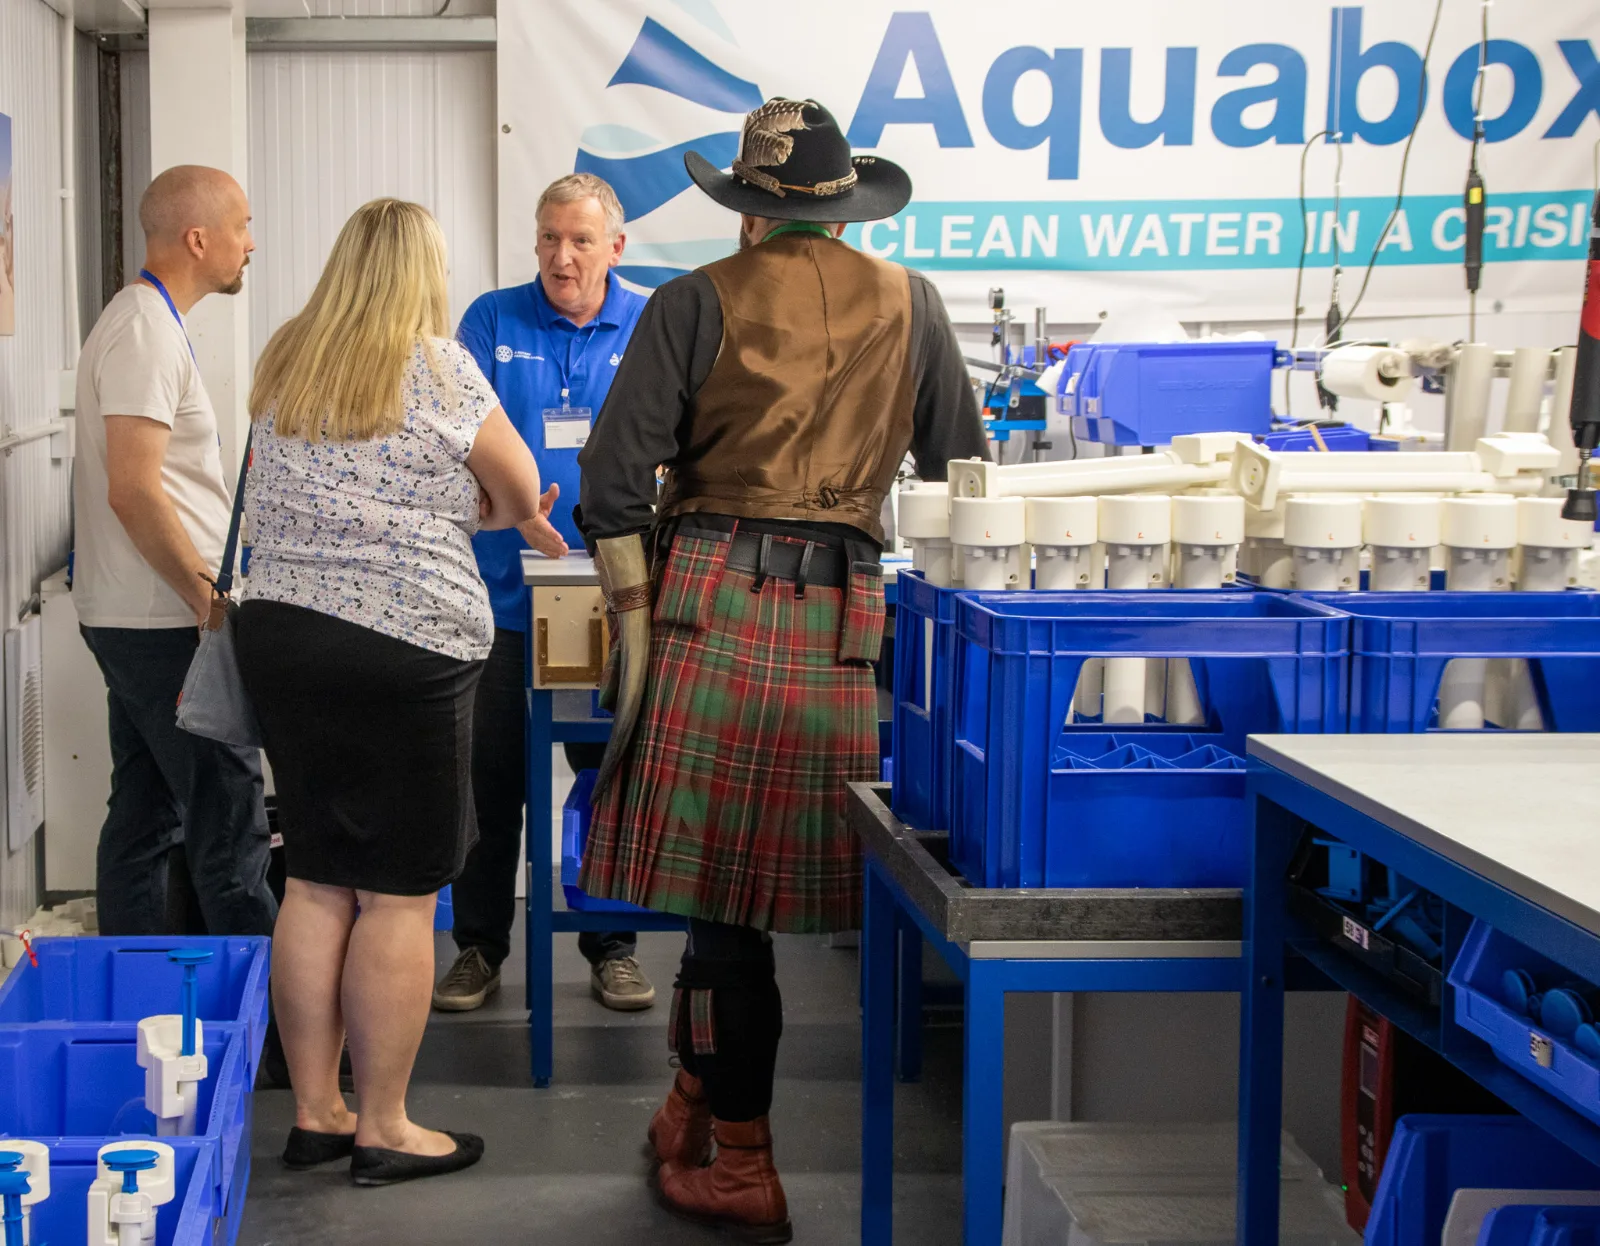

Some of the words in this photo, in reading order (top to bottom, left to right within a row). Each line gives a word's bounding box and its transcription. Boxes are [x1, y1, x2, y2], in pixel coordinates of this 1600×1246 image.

[845, 6, 1600, 180] Aquabox
[861, 214, 1059, 258] CLEAN
[1080, 212, 1283, 257] WATER
[1303, 209, 1360, 254] IN
[1372, 209, 1414, 252] A
[1431, 202, 1591, 251] CRISI
